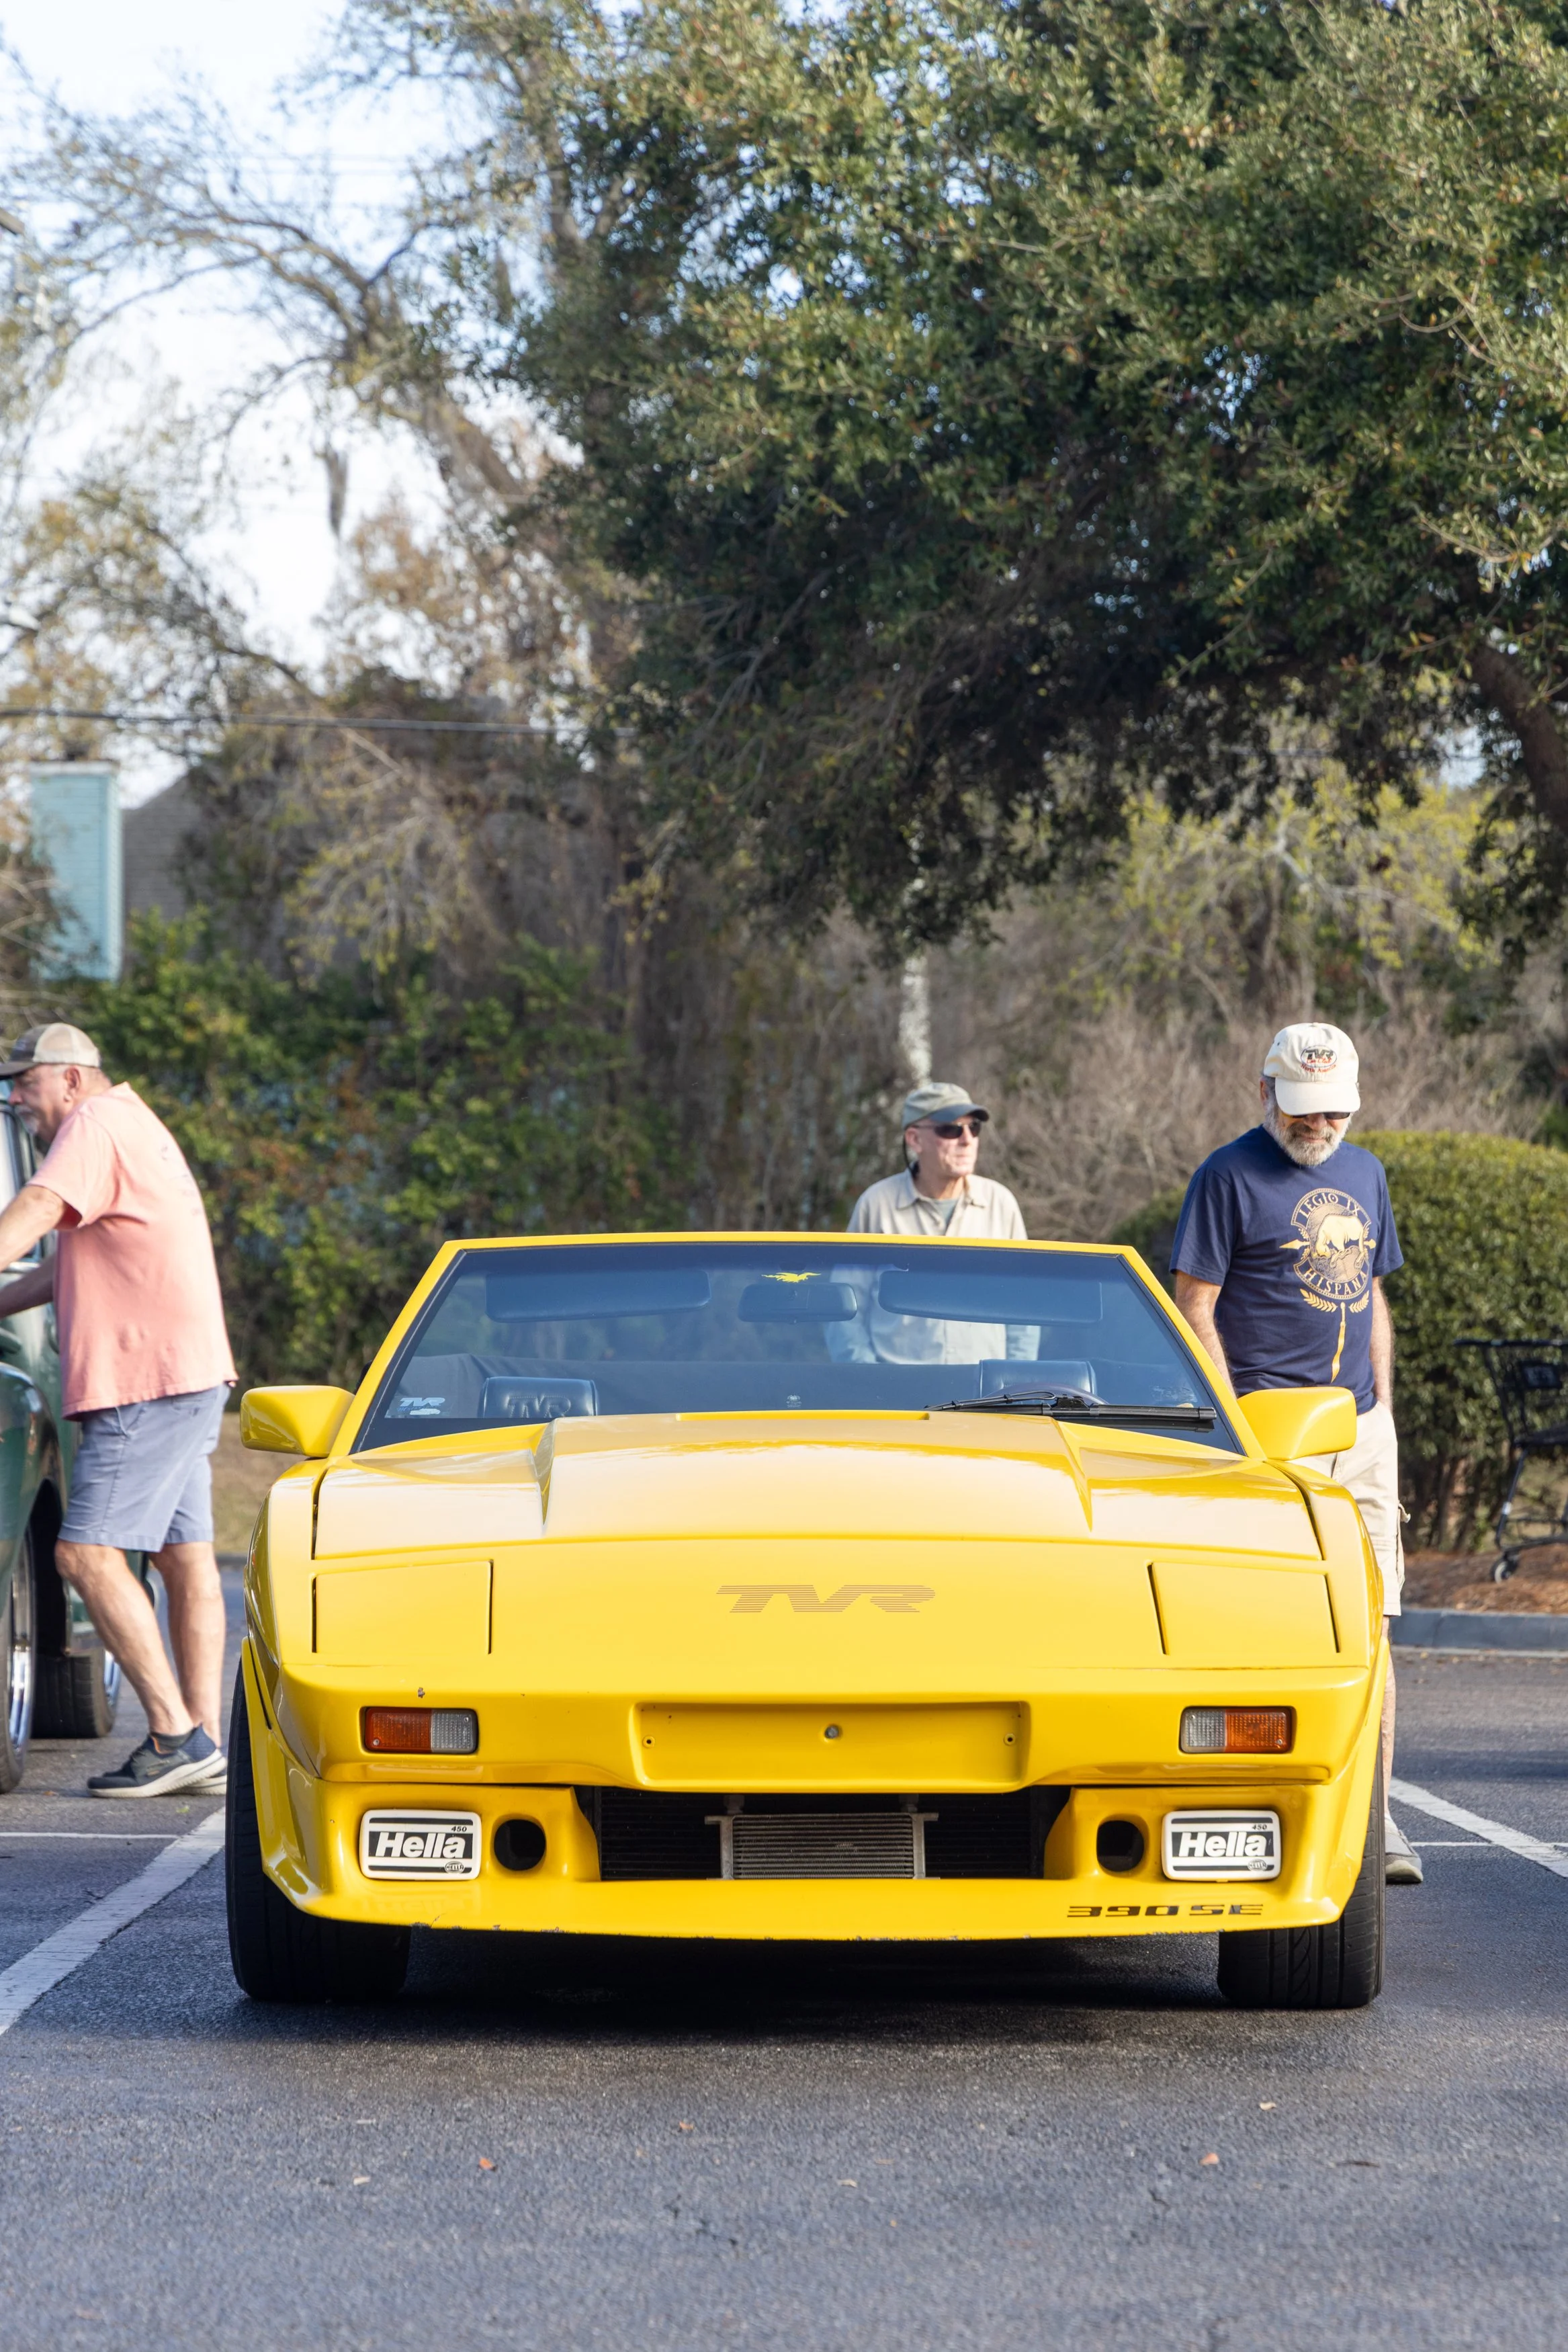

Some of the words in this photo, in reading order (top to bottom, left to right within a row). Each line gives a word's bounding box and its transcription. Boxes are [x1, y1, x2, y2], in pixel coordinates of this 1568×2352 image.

[1305, 1049, 1334, 1060] TVR
[1301, 1064, 1315, 1073] North
[1299, 1193, 1339, 1219] LEGIO
[1346, 1198, 1360, 1217] IX
[1303, 1267, 1367, 1295] HISPANA
[400, 1397, 445, 1407] TVR
[716, 1585, 936, 1613] TVR
[375, 1832, 466, 1858] Hella
[1178, 1831, 1268, 1857] Hella
[1067, 1905, 1180, 1917] 390
[1189, 1904, 1264, 1916] SE
